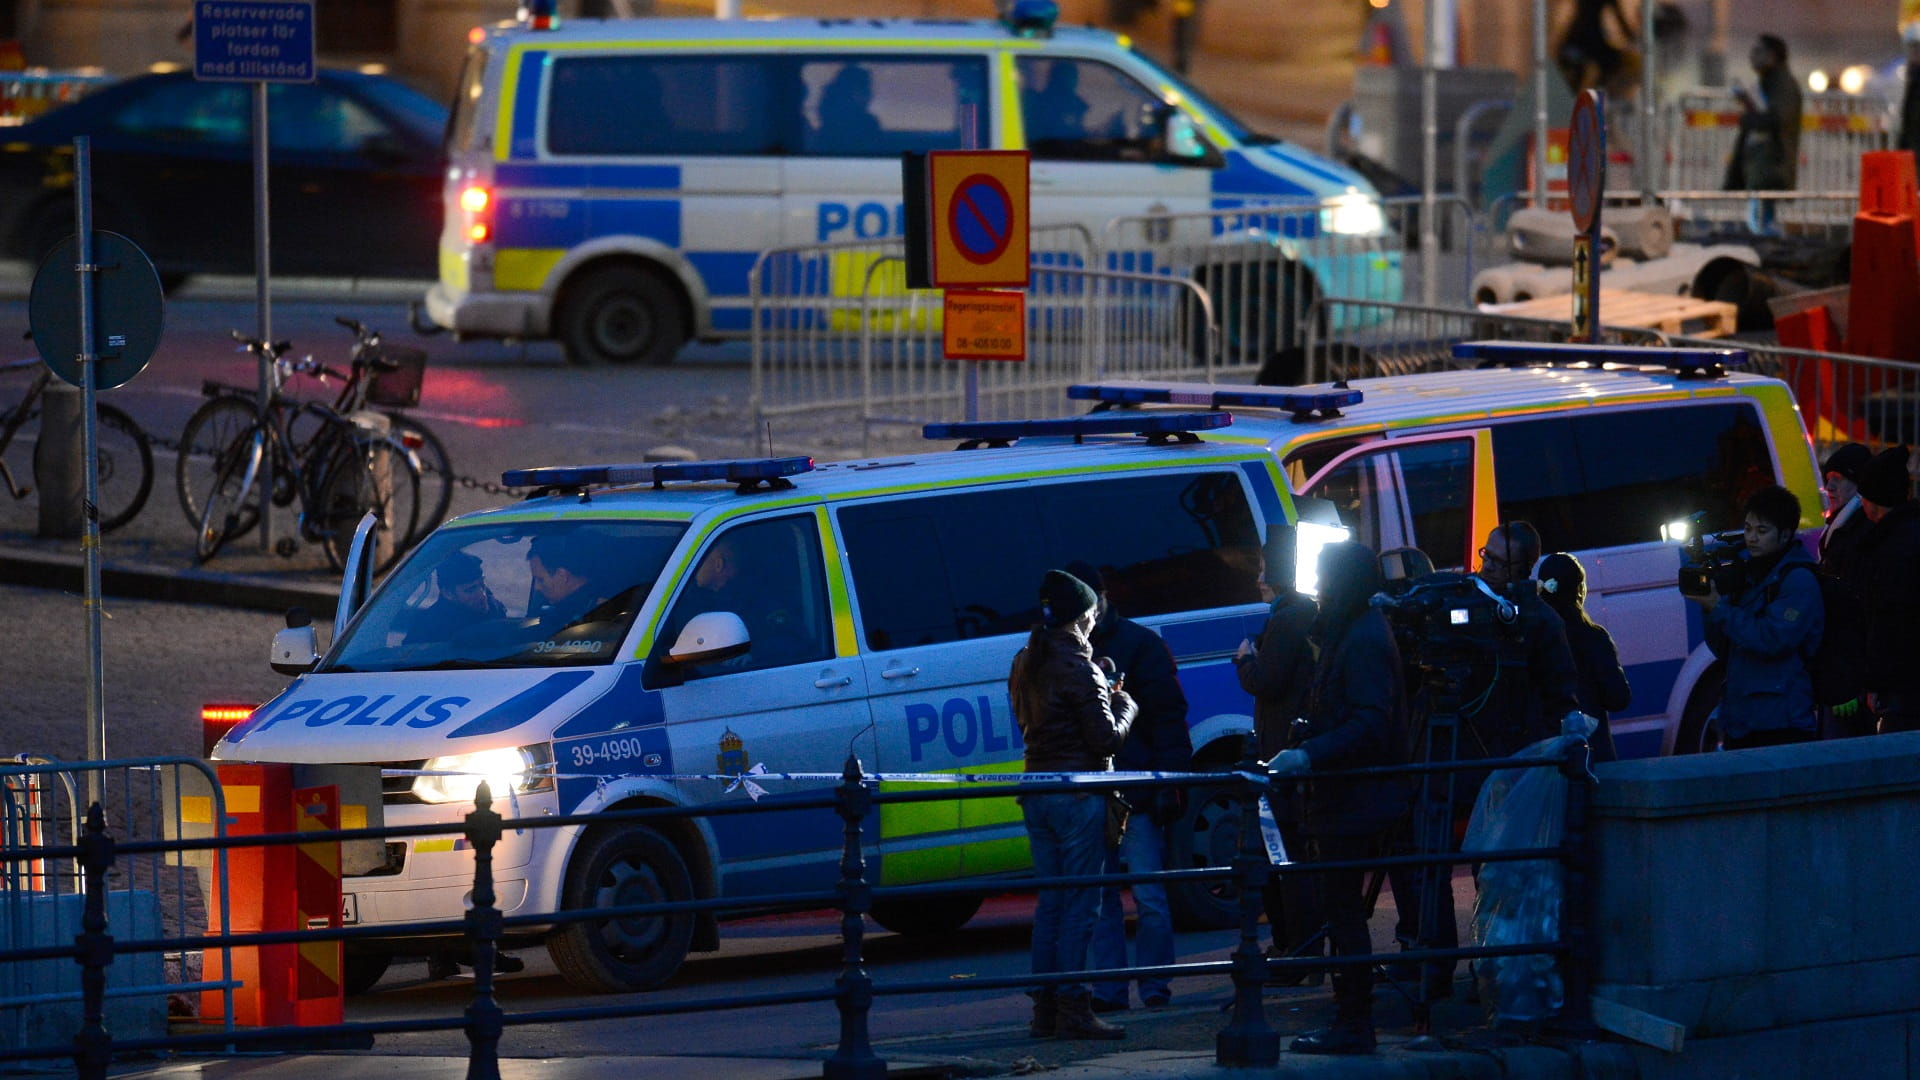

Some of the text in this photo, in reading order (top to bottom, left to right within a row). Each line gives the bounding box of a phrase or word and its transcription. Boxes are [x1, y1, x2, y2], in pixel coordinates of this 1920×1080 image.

[202, 3, 305, 21] Reserverade
[211, 23, 297, 40] platser för
[227, 41, 280, 57] fordon
[202, 60, 307, 78] med tillstånd
[534, 640, 602, 653] 39-4990
[254, 694, 472, 733] POLIS
[571, 738, 642, 767] 39-4990
